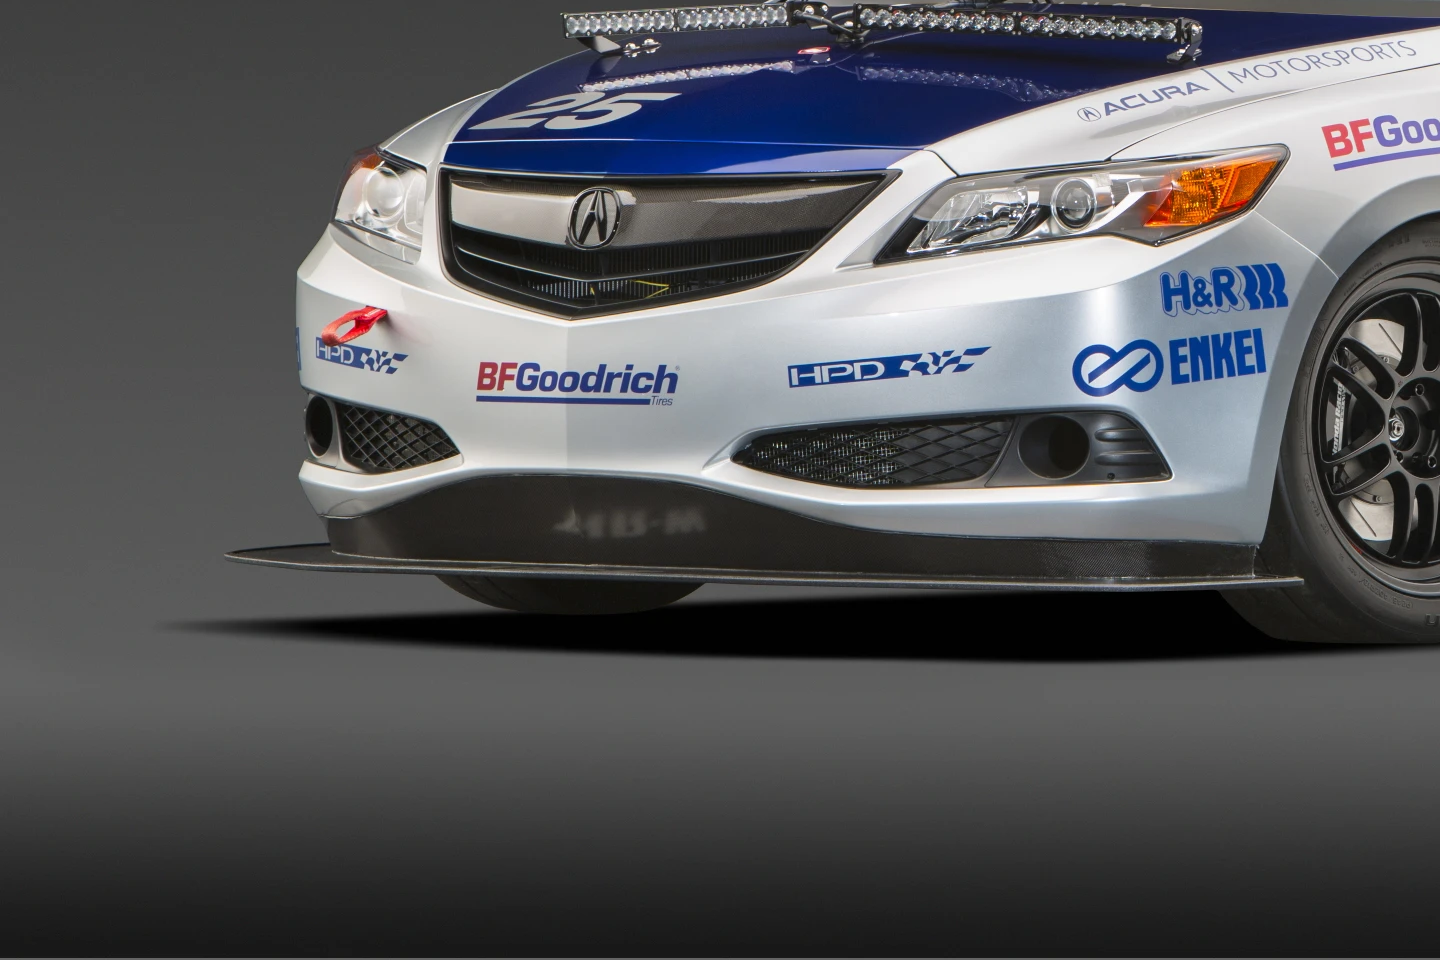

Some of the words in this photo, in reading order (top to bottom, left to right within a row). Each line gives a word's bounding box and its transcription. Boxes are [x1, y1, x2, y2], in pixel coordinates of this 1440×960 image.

[1105, 81, 1209, 116] ACURA
[1227, 40, 1417, 84] MOTORSPORTS
[468, 92, 682, 130] 25
[1160, 267, 1243, 315] H&R
[316, 339, 355, 365] HPD
[1168, 327, 1267, 386] ENKEI
[476, 361, 680, 394] BFGoodrich
[791, 360, 886, 387] HPD
[651, 395, 673, 406] Tires
